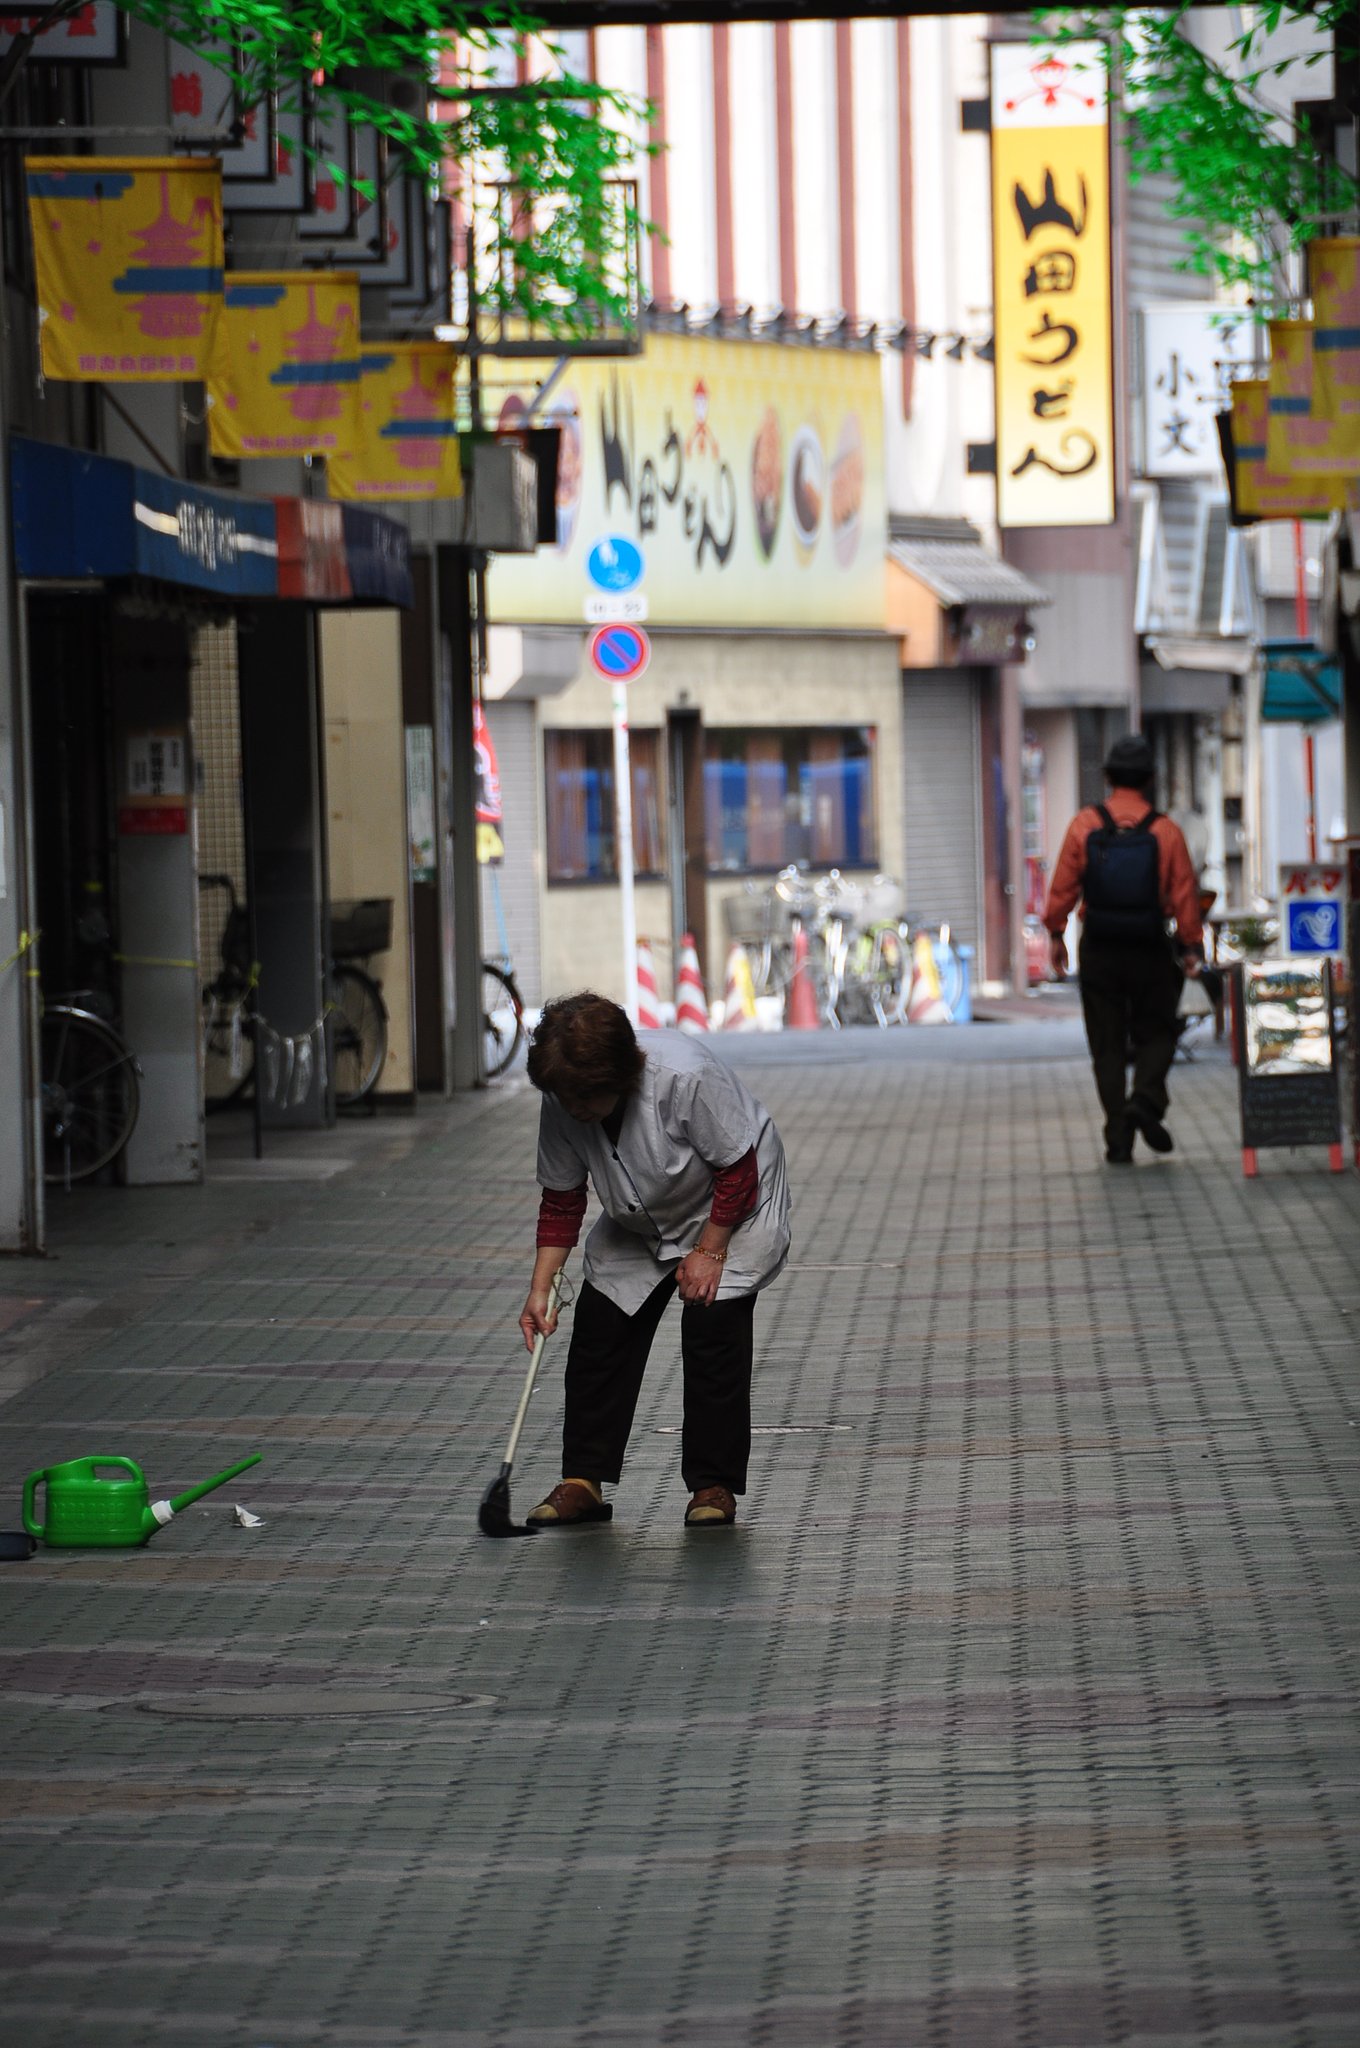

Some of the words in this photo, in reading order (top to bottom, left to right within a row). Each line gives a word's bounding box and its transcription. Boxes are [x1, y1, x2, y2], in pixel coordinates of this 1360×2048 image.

[1011, 166, 1097, 476] 山田うどん
[599, 363, 737, 569] 山田うどん
[1285, 871, 1341, 894] パーマ
